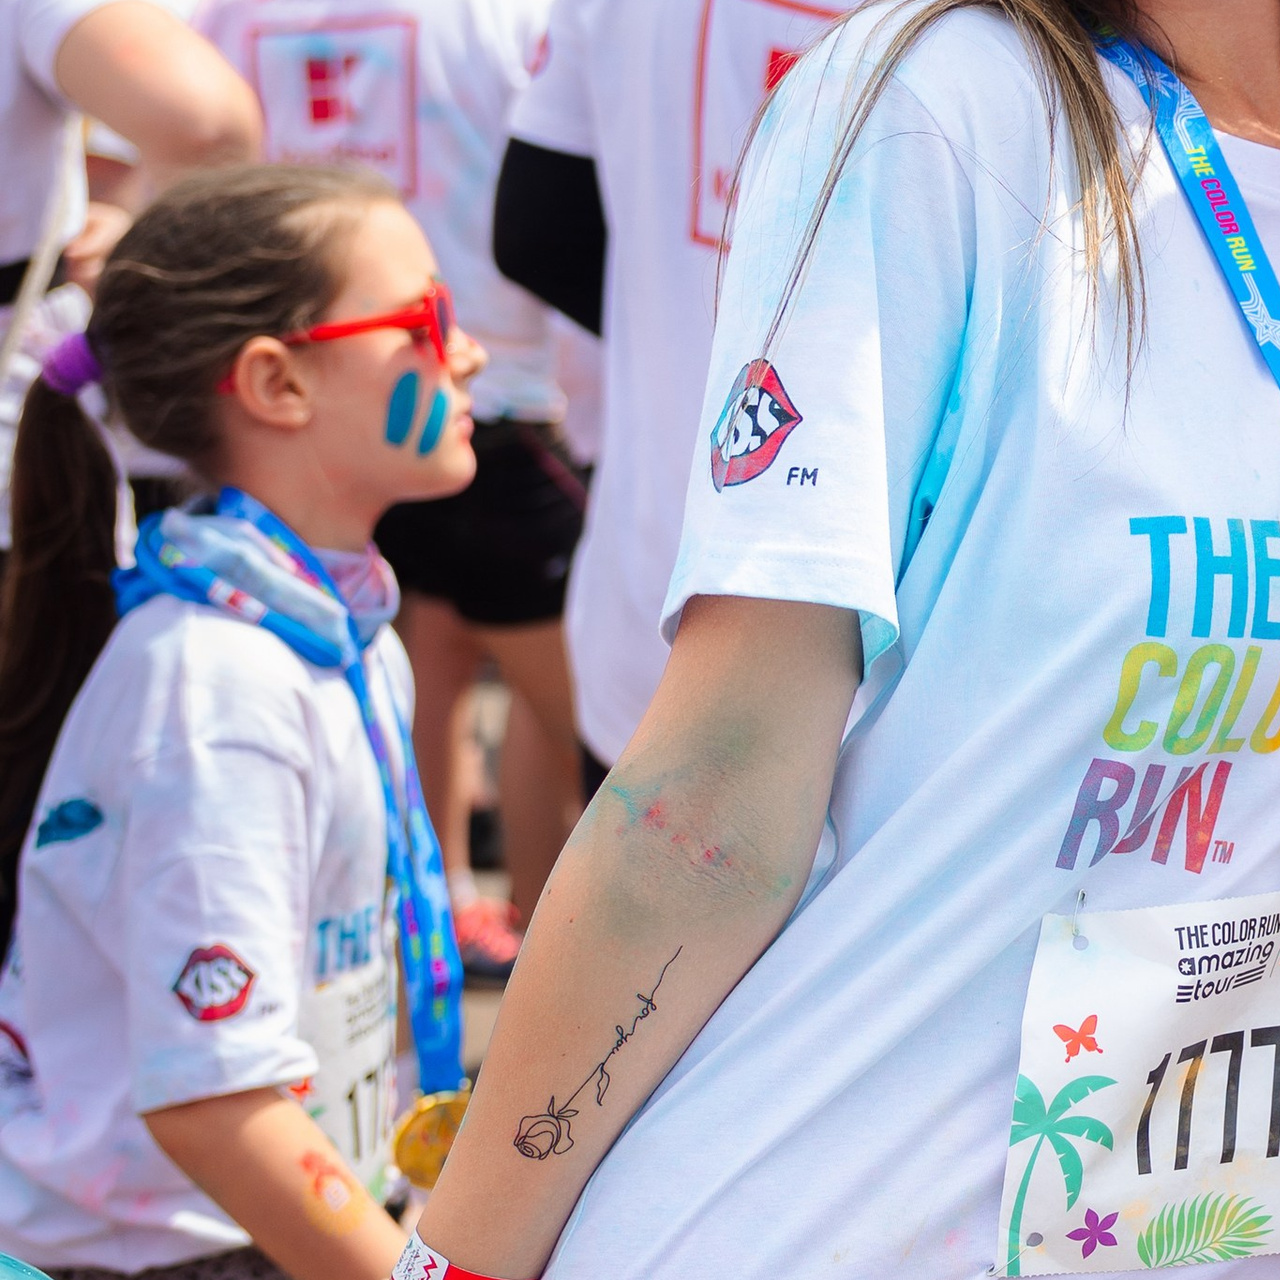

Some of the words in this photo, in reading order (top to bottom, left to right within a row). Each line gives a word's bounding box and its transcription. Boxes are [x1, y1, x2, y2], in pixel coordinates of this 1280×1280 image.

[1186, 145, 1216, 179] THE
[1200, 178, 1241, 236] COLOR
[1226, 235, 1257, 273] RUN
[786, 467, 819, 487] FM
[1055, 757, 1234, 875] RUN
[1174, 924, 1209, 951] THE
[1211, 918, 1258, 948] COLOR
[1178, 939, 1275, 976] amazing
[1193, 974, 1236, 1001] tour
